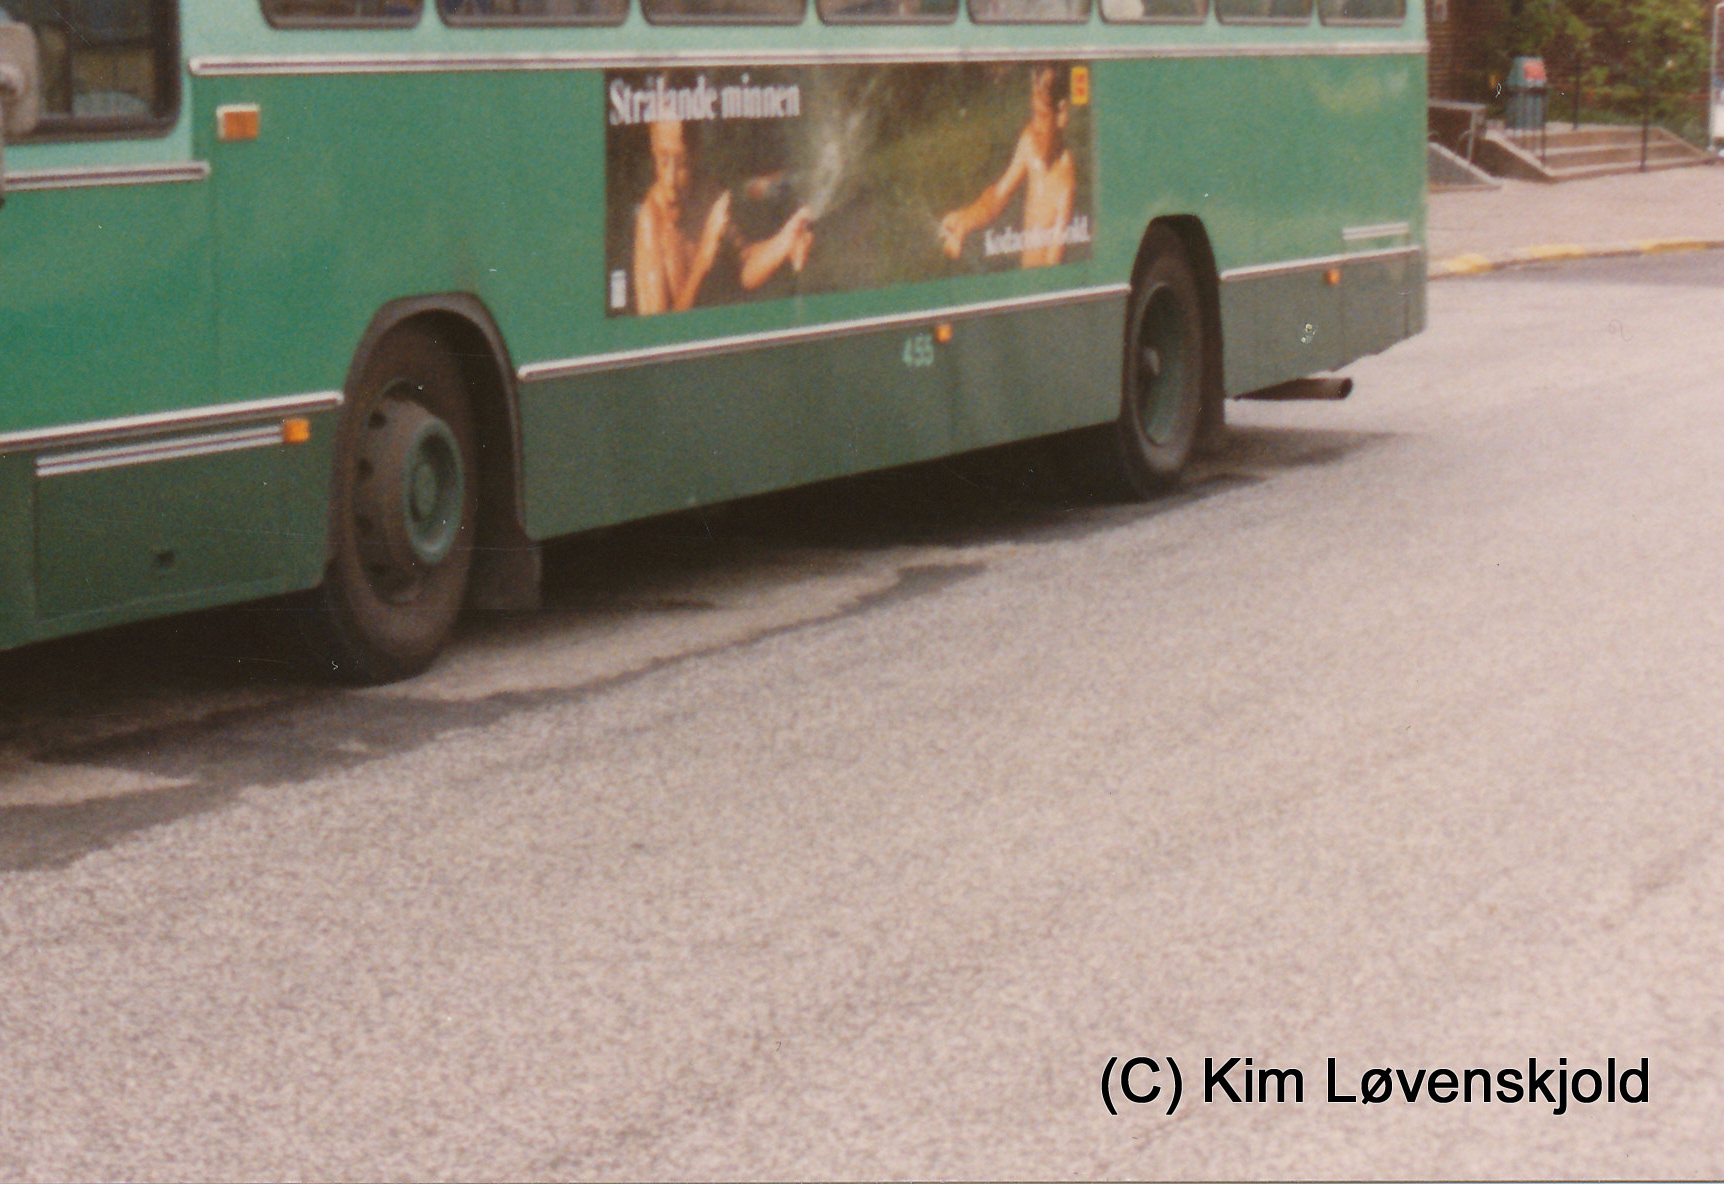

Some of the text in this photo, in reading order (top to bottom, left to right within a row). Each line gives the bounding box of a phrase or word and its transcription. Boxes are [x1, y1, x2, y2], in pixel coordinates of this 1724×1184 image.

[608, 72, 801, 126] Strålande minnen
[901, 332, 935, 367] 455
